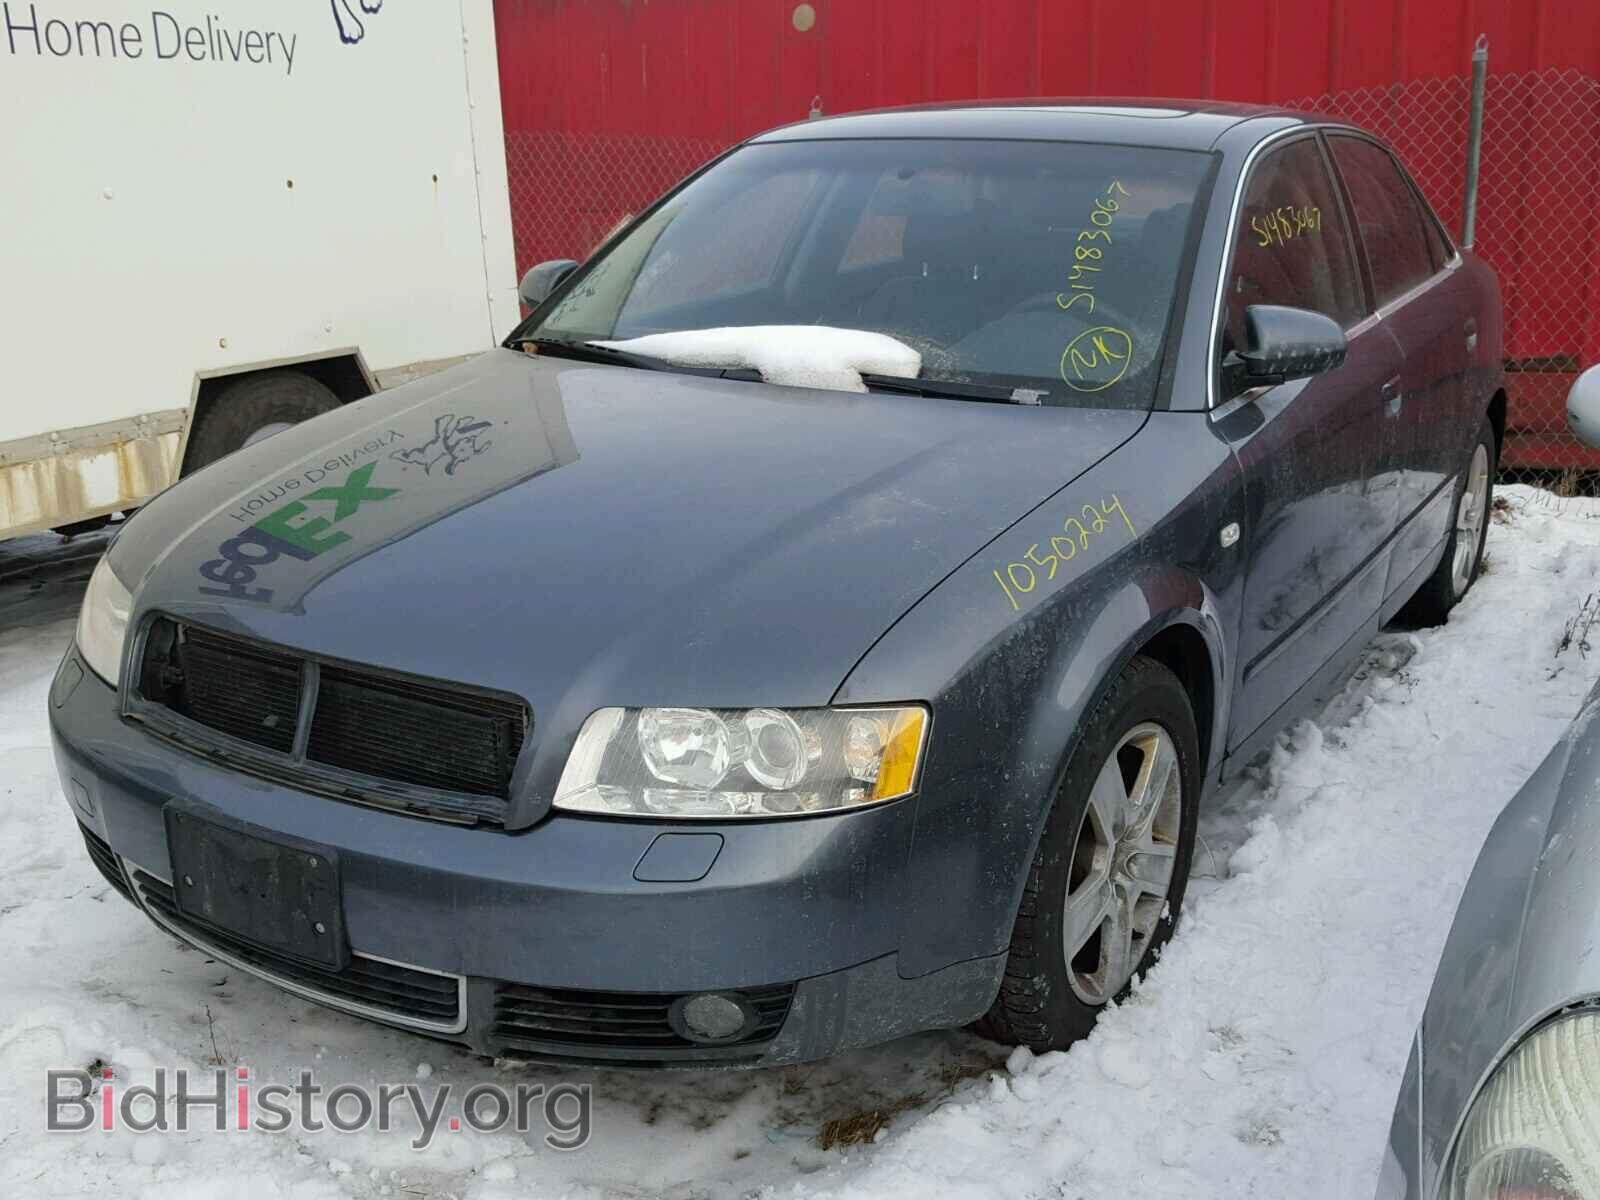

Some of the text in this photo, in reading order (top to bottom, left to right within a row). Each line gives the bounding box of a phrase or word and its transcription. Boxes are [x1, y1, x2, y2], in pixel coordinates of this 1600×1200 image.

[3, 2, 296, 75] Home Delivery
[993, 494, 1138, 611] 1050224
